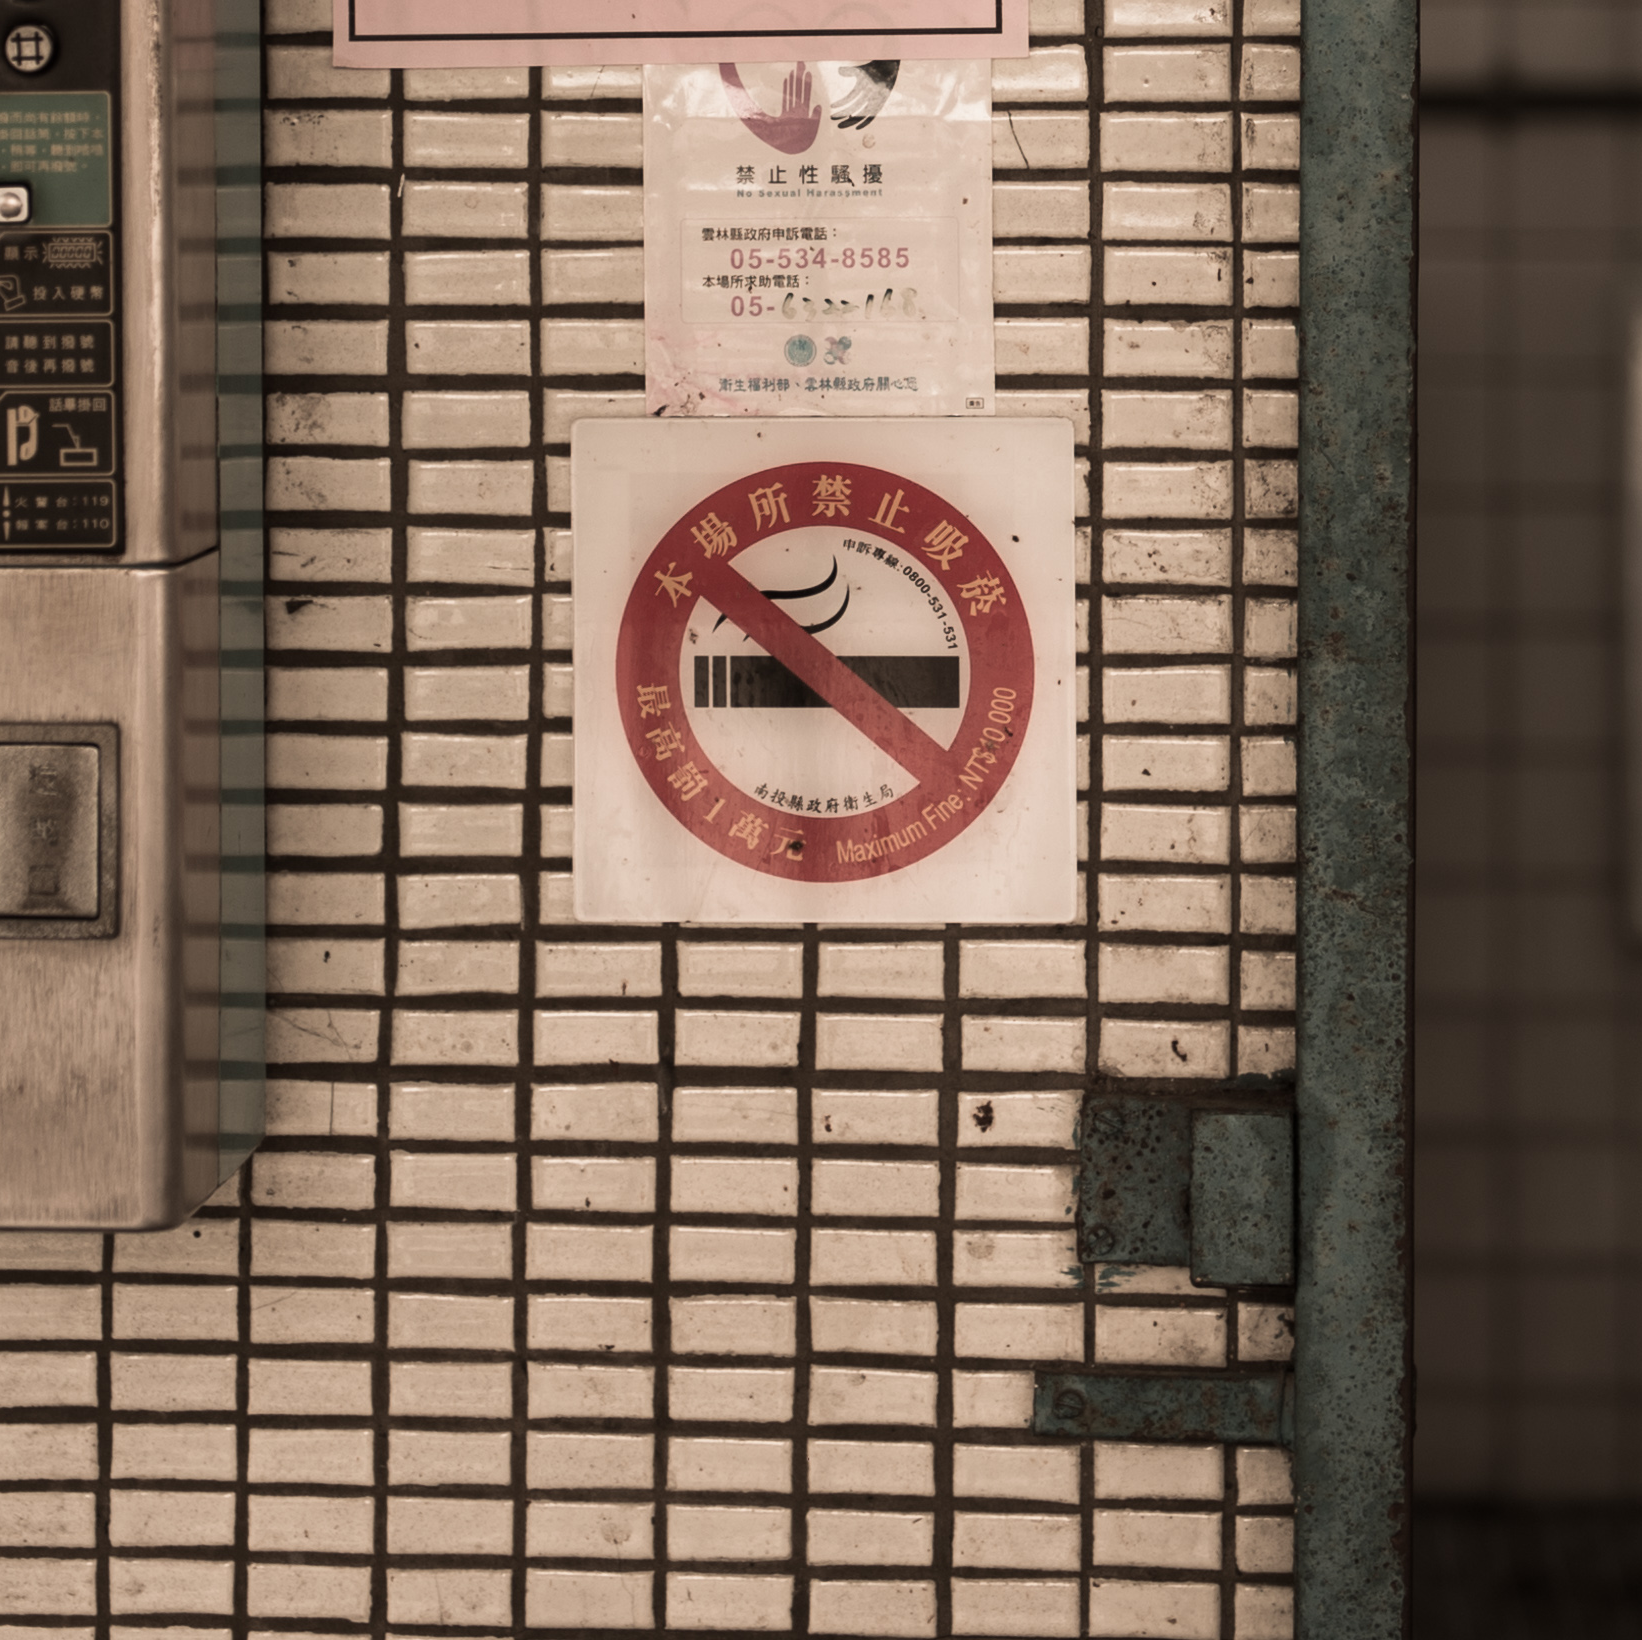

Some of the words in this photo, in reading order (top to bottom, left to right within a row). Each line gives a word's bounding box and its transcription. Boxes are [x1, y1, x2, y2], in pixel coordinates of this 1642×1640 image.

[736, 163, 884, 186] 禁止性騷擾
[736, 189, 753, 198] No
[759, 188, 802, 198] Sexual
[730, 247, 911, 270] 05-534-8585
[653, 474, 1007, 617] 本場所禁止吸菸
[836, 821, 928, 865] Maximum
